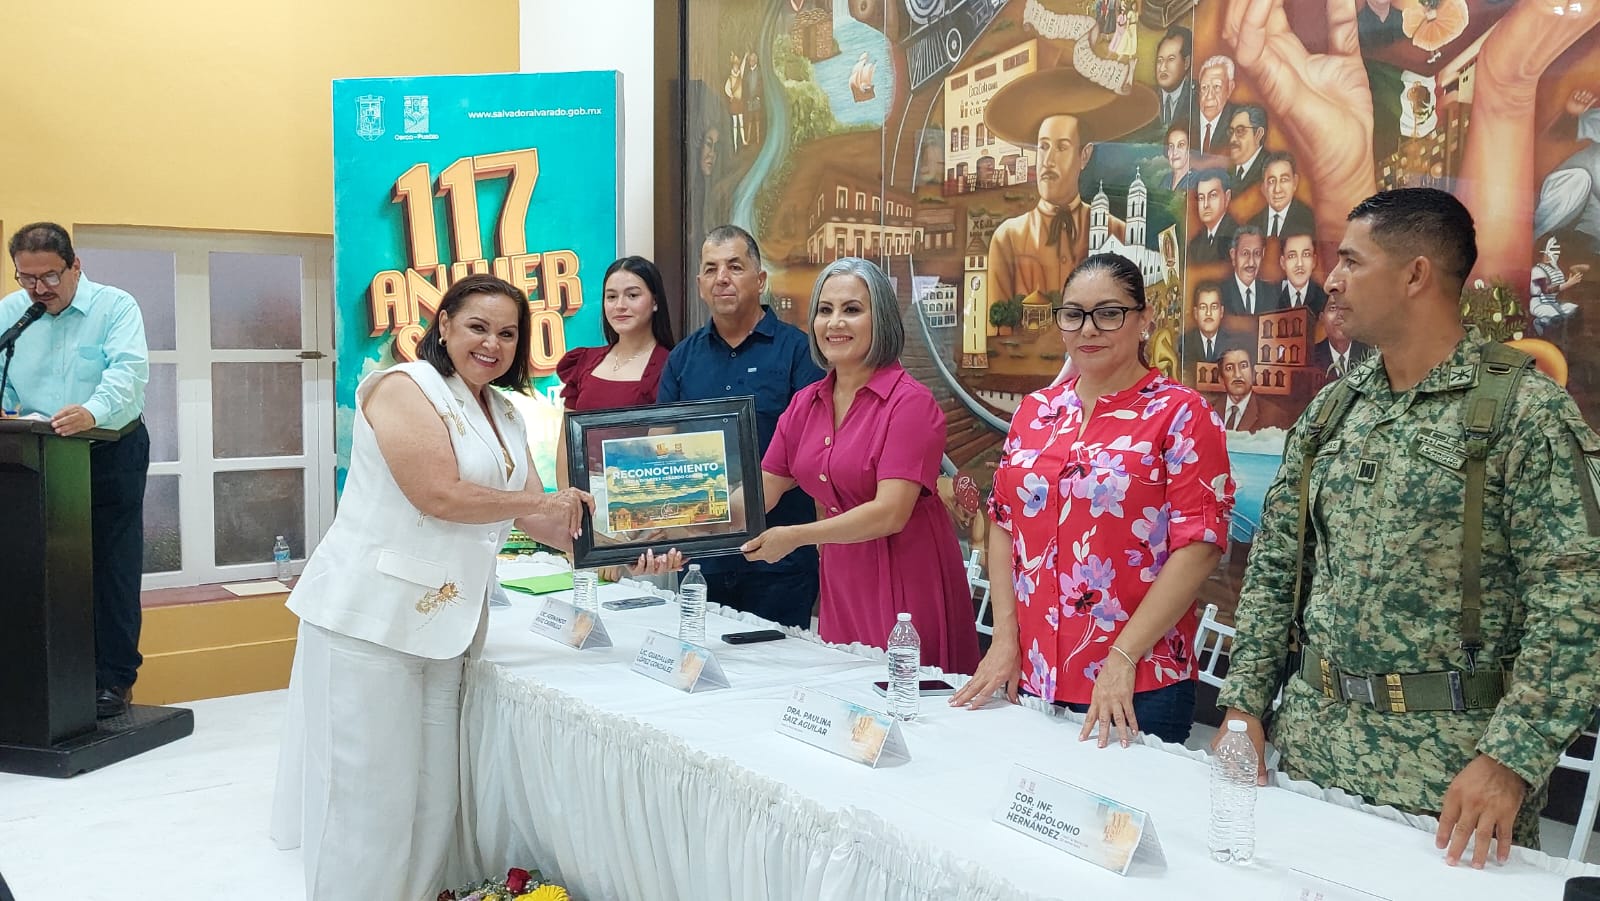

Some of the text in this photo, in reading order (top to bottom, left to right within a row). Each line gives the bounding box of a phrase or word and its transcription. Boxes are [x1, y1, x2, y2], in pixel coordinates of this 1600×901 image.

[468, 107, 602, 119] www.salvadoralvarado.gob.mx
[391, 147, 540, 268] 117
[613, 462, 718, 479] RECONOCIMIENTO
[787, 706, 801, 717] DRA.
[803, 712, 831, 728] PAULINA
[798, 720, 828, 736] AGUILAR
[1015, 792, 1053, 814] COR. INF.
[1007, 812, 1060, 840] HERNÁNDEZ
[1010, 801, 1080, 836] JOSÉ APOLONIO
